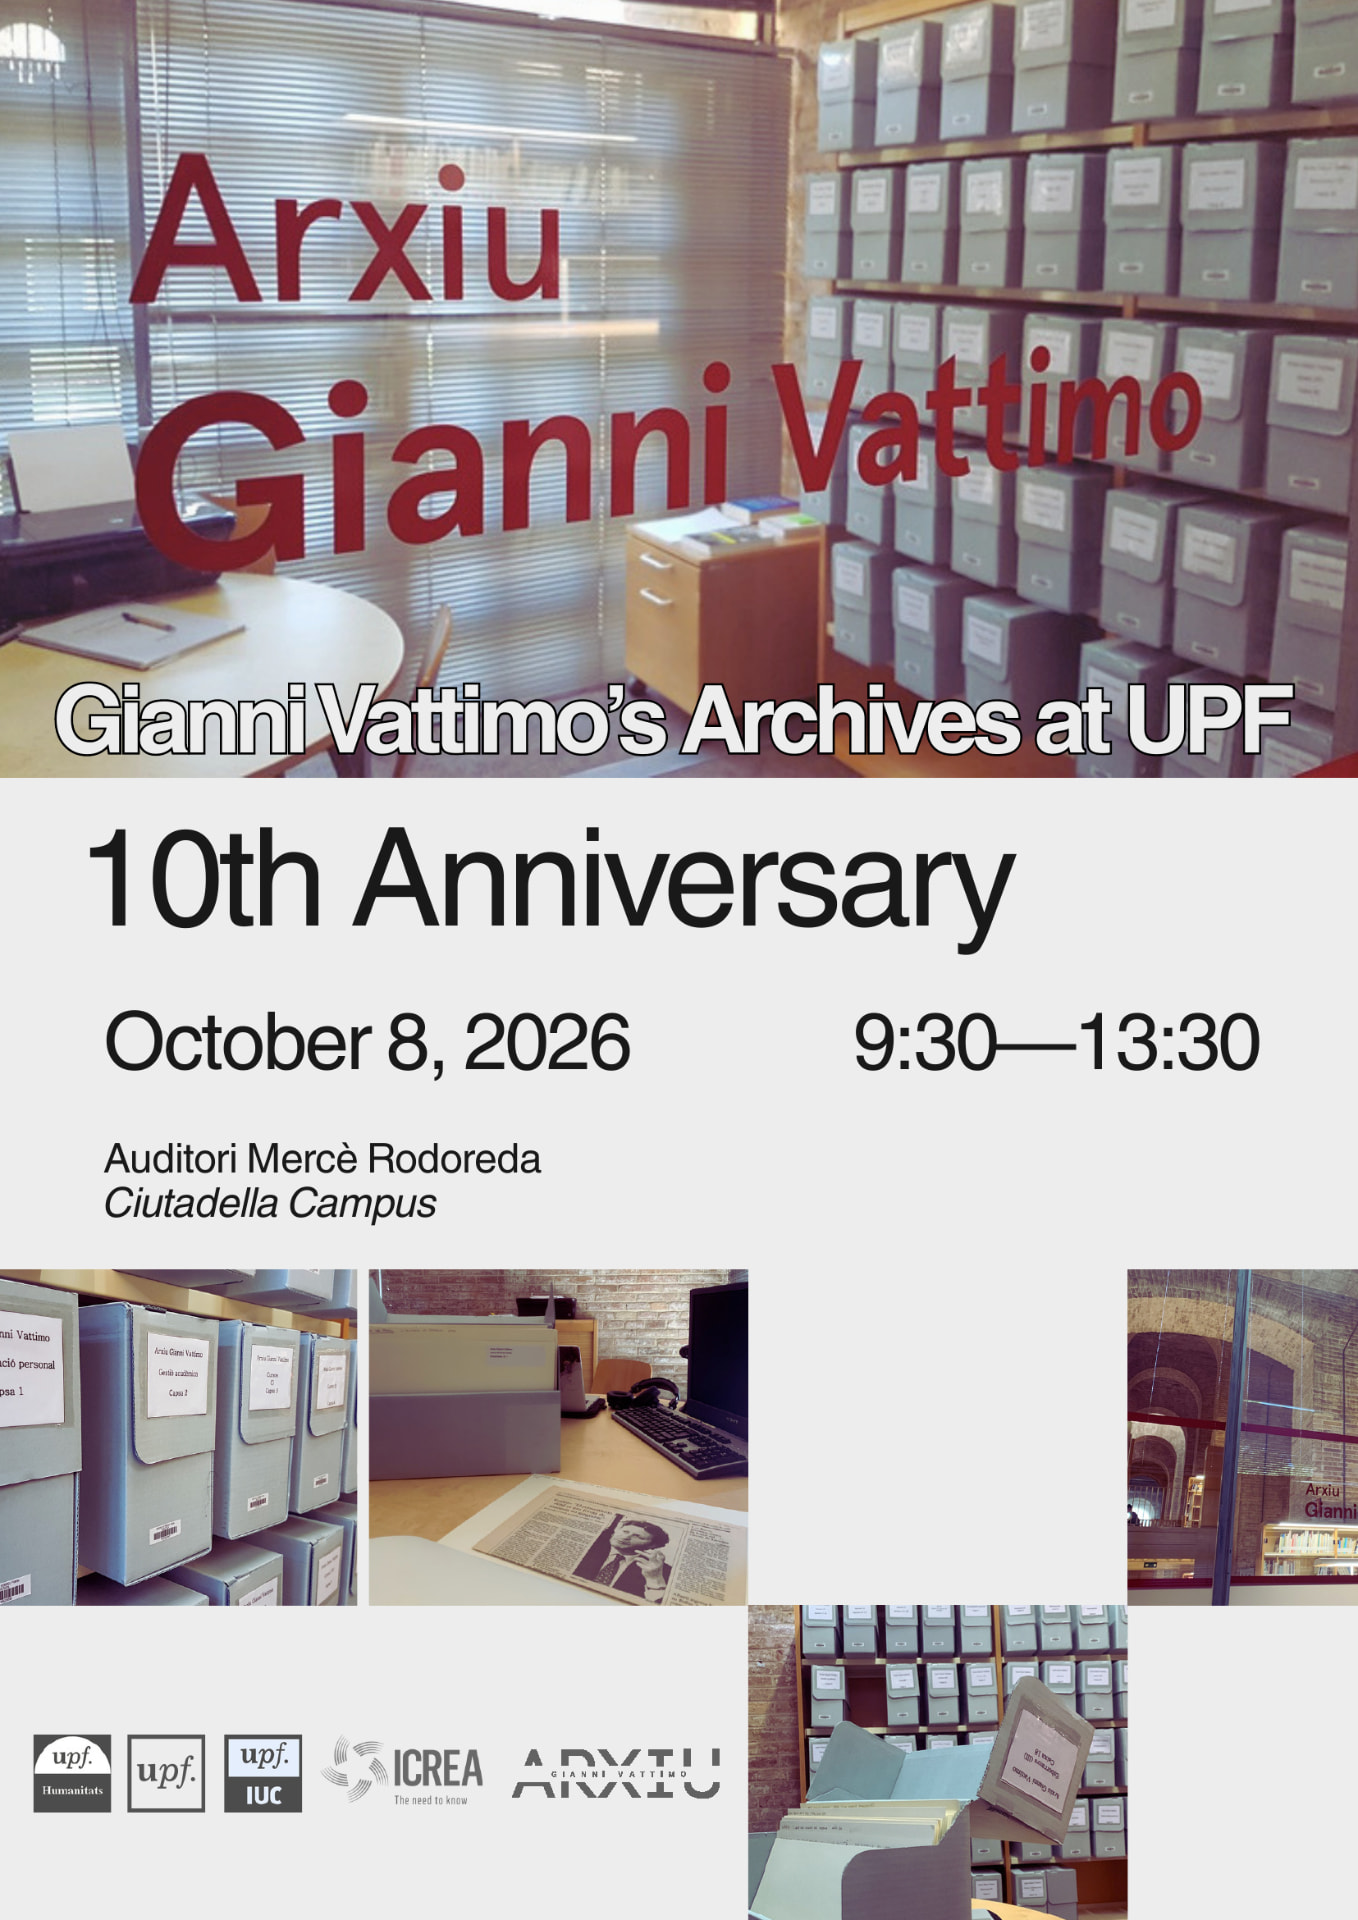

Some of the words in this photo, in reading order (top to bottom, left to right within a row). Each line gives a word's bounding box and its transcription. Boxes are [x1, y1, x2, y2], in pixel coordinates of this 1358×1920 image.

[130, 152, 560, 304] Arxiu
[136, 361, 732, 572] Gianni
[771, 345, 1203, 492] Vattimo
[55, 682, 306, 757] Gianni
[315, 683, 668, 757] Vattimo’s
[679, 683, 1022, 757] Archives
[1035, 687, 1113, 757] at
[1127, 683, 1296, 757] UPF
[90, 826, 320, 929] 10th
[352, 826, 1017, 956] Anniversary
[106, 1009, 373, 1072] October
[388, 1012, 444, 1082] 8,
[465, 1012, 631, 1072] 2026
[104, 1142, 236, 1174] Auditori
[248, 1141, 358, 1174] Mercè
[369, 1142, 542, 1174] Rodoreda
[105, 1185, 279, 1219] Ciutadella
[289, 1185, 438, 1226] Campus
[16, 1330, 51, 1342] Vattimo
[18, 1360, 55, 1370] personal
[19, 1386, 24, 1396] 1
[1305, 1482, 1340, 1497] Arxiu
[1305, 1501, 1357, 1520] Gianni
[52, 1745, 93, 1770] upf.
[240, 1741, 289, 1770] upf.
[394, 1748, 483, 1787] ICREA
[136, 1755, 196, 1790] upf.
[511, 1748, 721, 1800] ARXIU
[551, 1769, 606, 1778] GIANNI
[617, 1769, 687, 1778] VATTIMO
[42, 1785, 104, 1795] Humanitats
[246, 1785, 282, 1805] IUC
[394, 1794, 410, 1805] The
[412, 1794, 432, 1805] need
[434, 1795, 443, 1805] to
[446, 1794, 468, 1805] know
